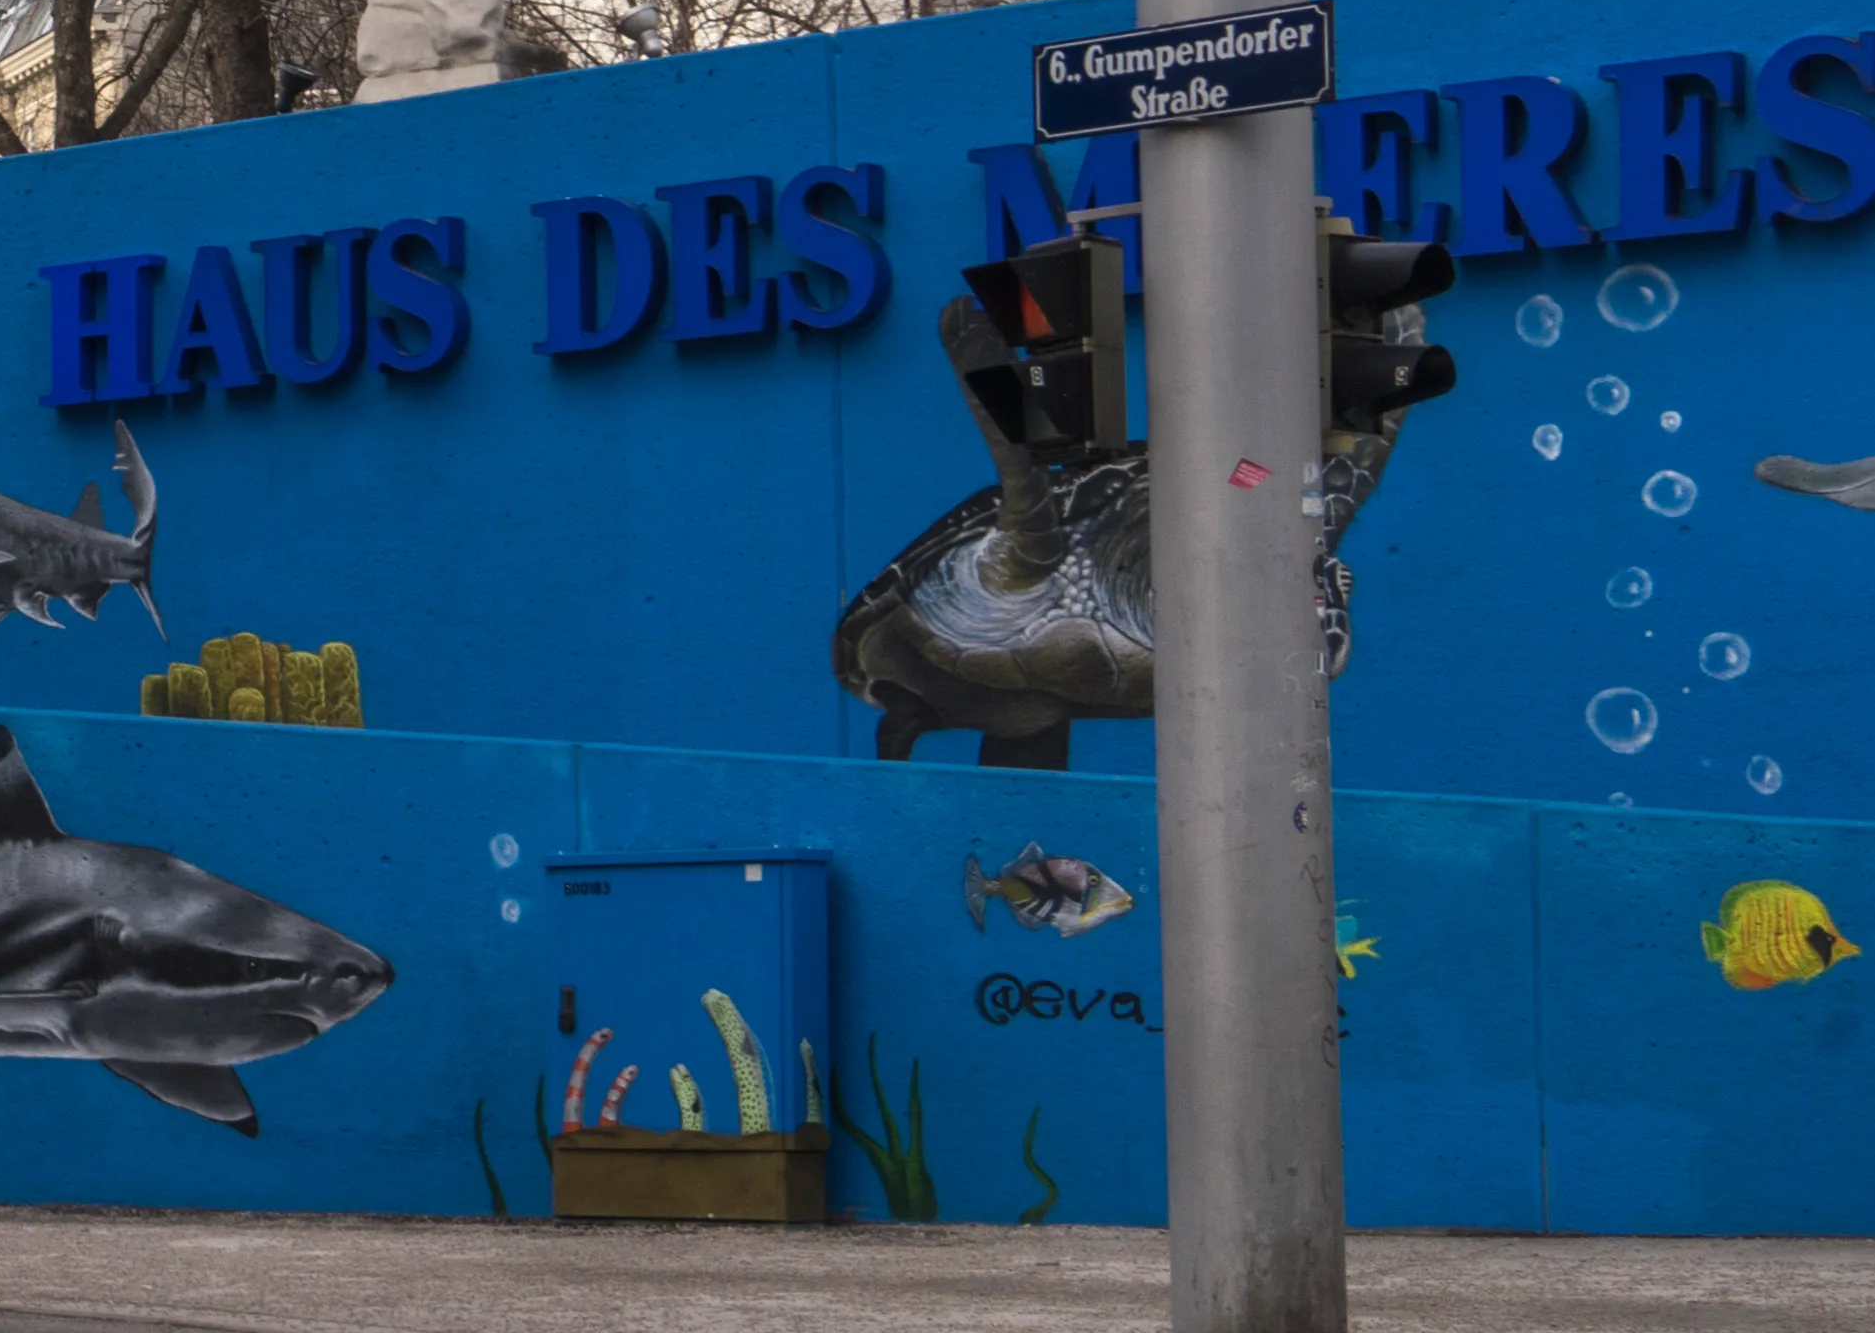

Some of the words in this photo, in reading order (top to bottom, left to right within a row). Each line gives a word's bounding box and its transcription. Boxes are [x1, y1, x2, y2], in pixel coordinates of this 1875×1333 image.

[1084, 17, 1316, 81] Gumpendorfer
[1130, 76, 1229, 120] Straße
[37, 216, 471, 409] HAUS
[530, 162, 892, 356] DES
[967, 30, 1875, 311] MERES
